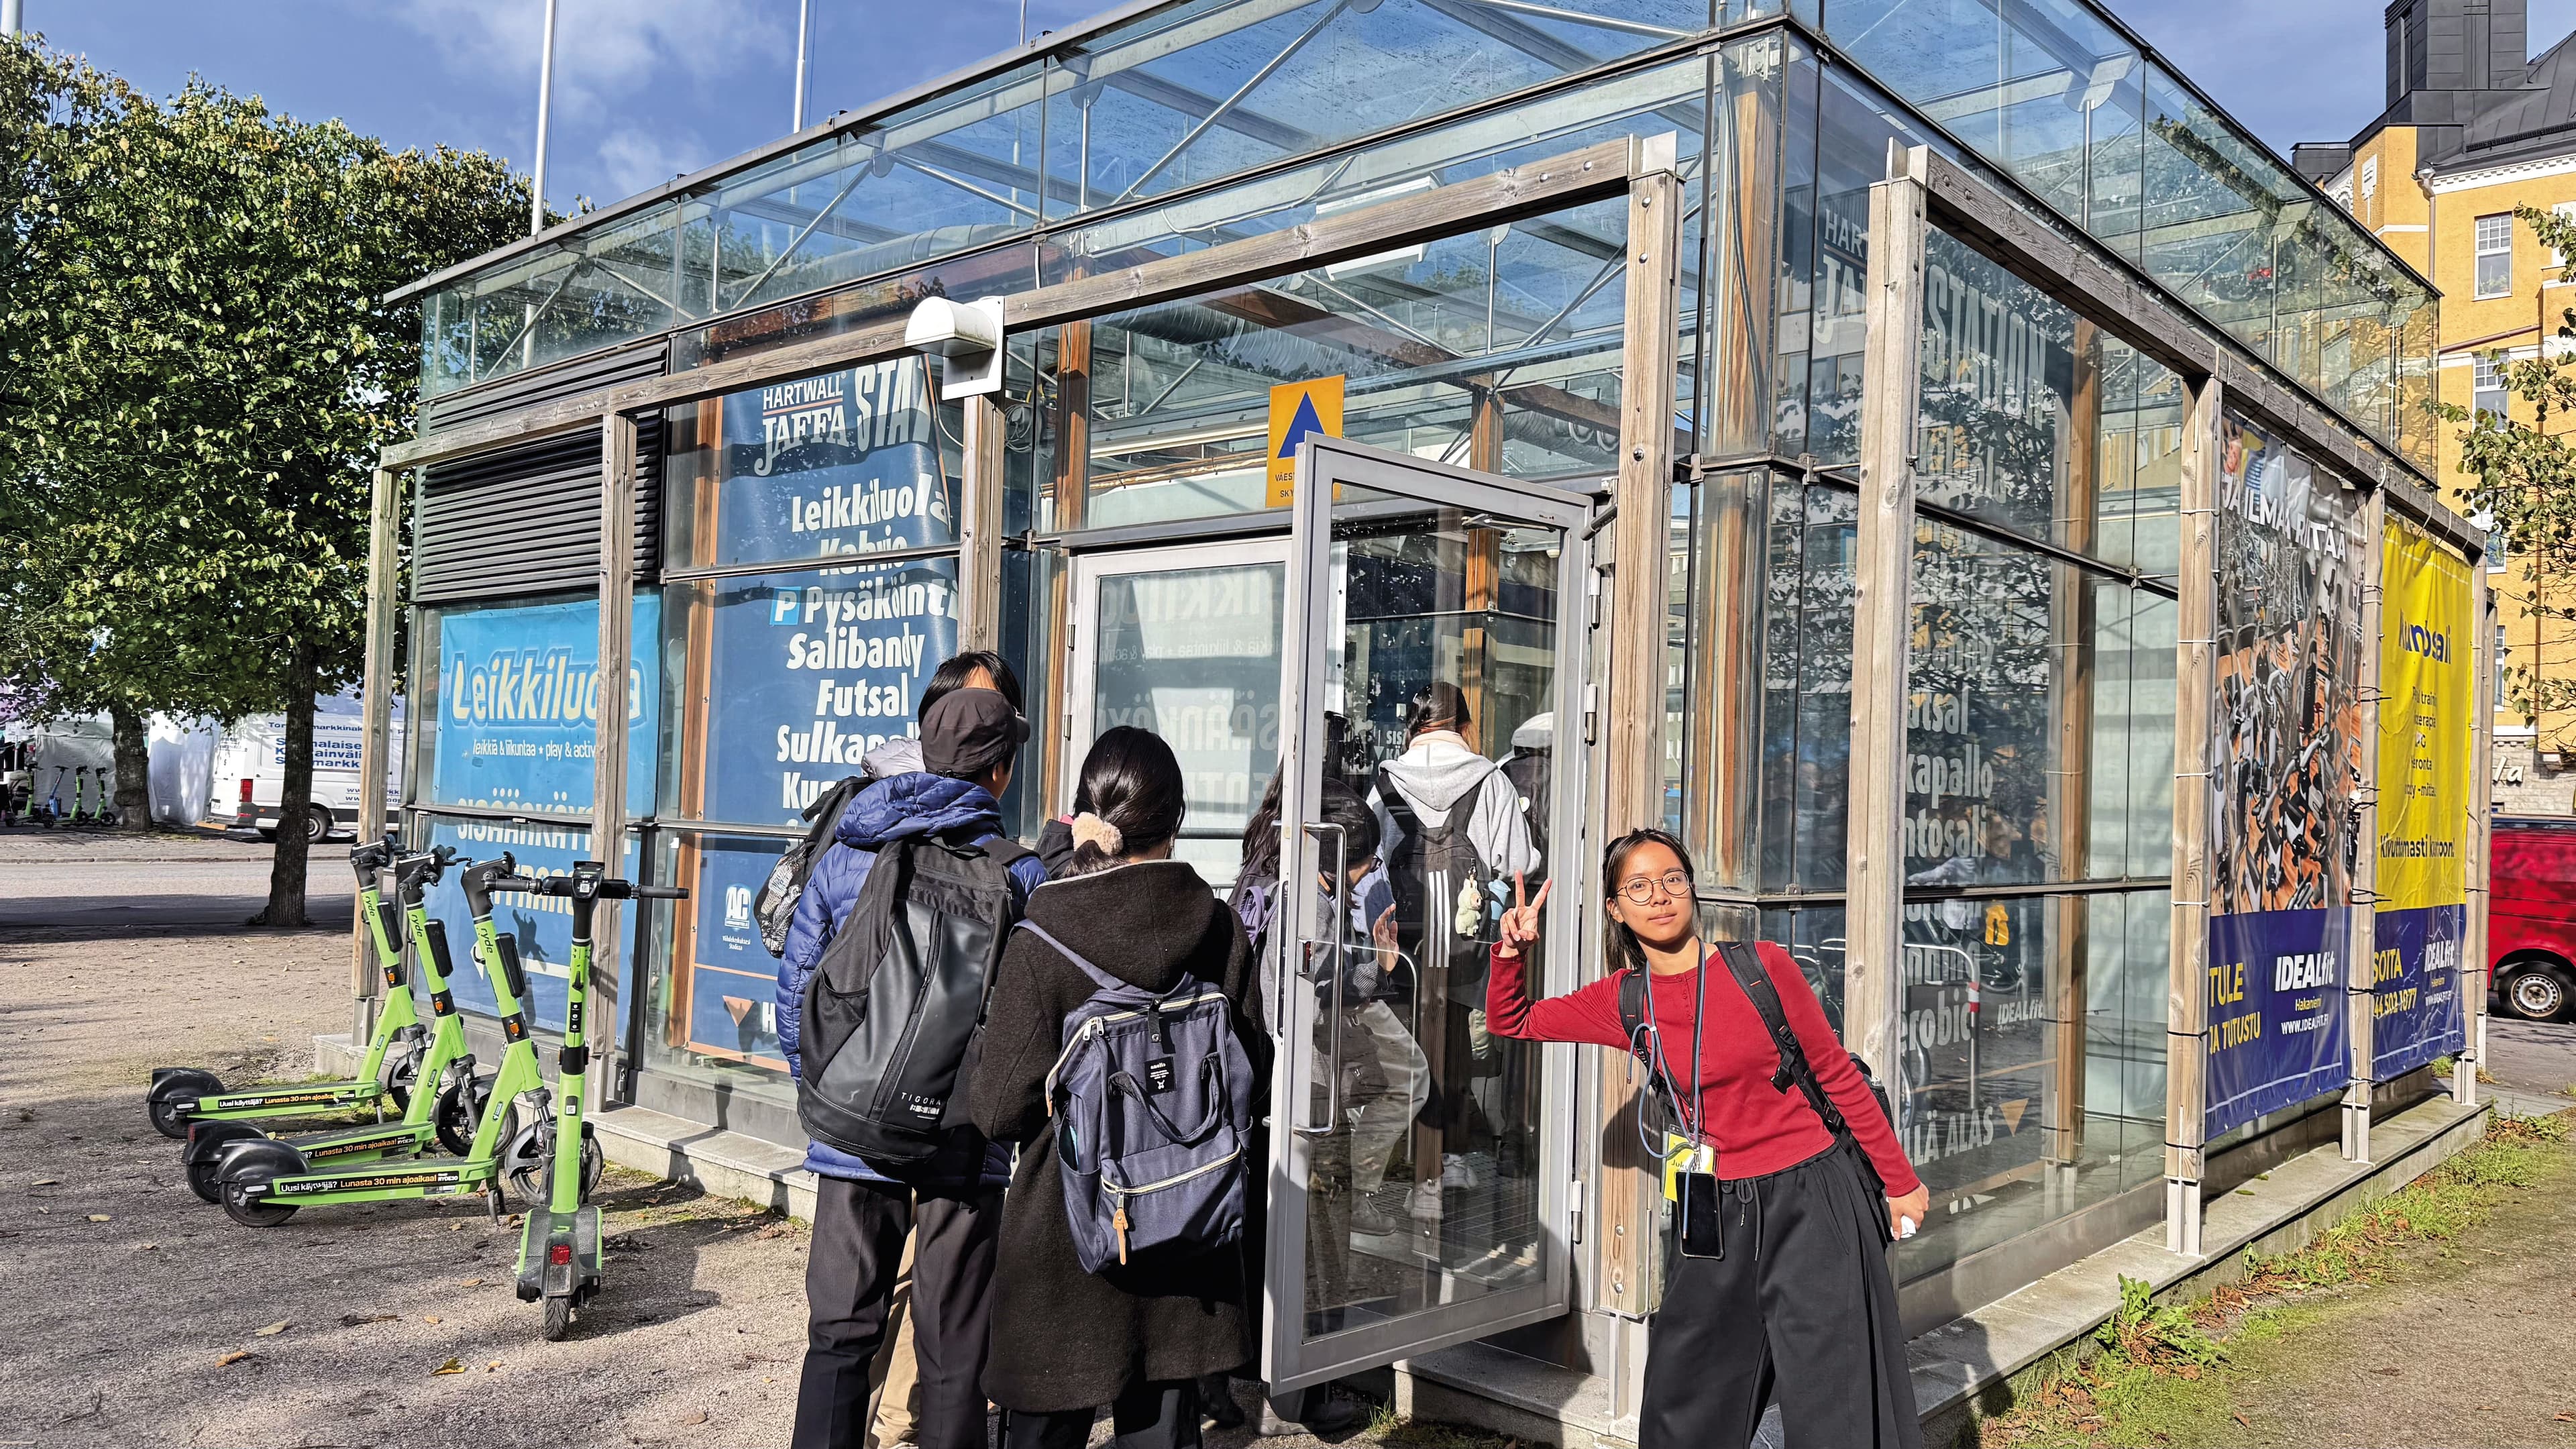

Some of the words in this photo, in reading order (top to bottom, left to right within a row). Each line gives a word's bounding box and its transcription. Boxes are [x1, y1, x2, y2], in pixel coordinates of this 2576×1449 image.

[1926, 265, 2047, 431] STATION
[763, 374, 844, 411] HARTWALL
[754, 405, 849, 476] JAFFA
[1275, 472, 1295, 482] VÄES
[1280, 489, 1294, 498] SKY
[2222, 472, 2241, 515] JA
[775, 591, 797, 621] P
[805, 572, 958, 633] Pysäköinti
[786, 623, 925, 678] Salibandy
[452, 656, 641, 720] Leikkiluoa
[816, 672, 909, 716] Futsal
[472, 739, 498, 756] leikkiä
[505, 739, 536, 757] liikuntaa
[545, 739, 563, 761] play
[564, 741, 572, 757] &
[574, 740, 596, 758] activ
[2492, 755, 2524, 782] la
[411, 914, 423, 938] ryde
[480, 927, 494, 954] ryde
[2209, 962, 2244, 1008] TULE
[2275, 950, 2334, 992] IDEALfit
[2209, 1024, 2220, 1055] JA
[2222, 1011, 2261, 1050] TUTUSTU
[264, 1096, 289, 1105] Lunasta
[901, 1091, 941, 1106] TIGORA
[315, 1148, 343, 1158] Lunasta
[343, 1145, 353, 1154] 30
[354, 1143, 367, 1152] min
[368, 1138, 396, 1150] ajoaikaa!
[1900, 1110, 1939, 1167] LLÄ
[1945, 1106, 1994, 1157] ALAS
[281, 1184, 300, 1192] Uusi
[340, 1179, 372, 1188] Lunasta
[374, 1178, 385, 1186] 30
[386, 1176, 401, 1185] min
[402, 1174, 437, 1186] ajoaikaa!
